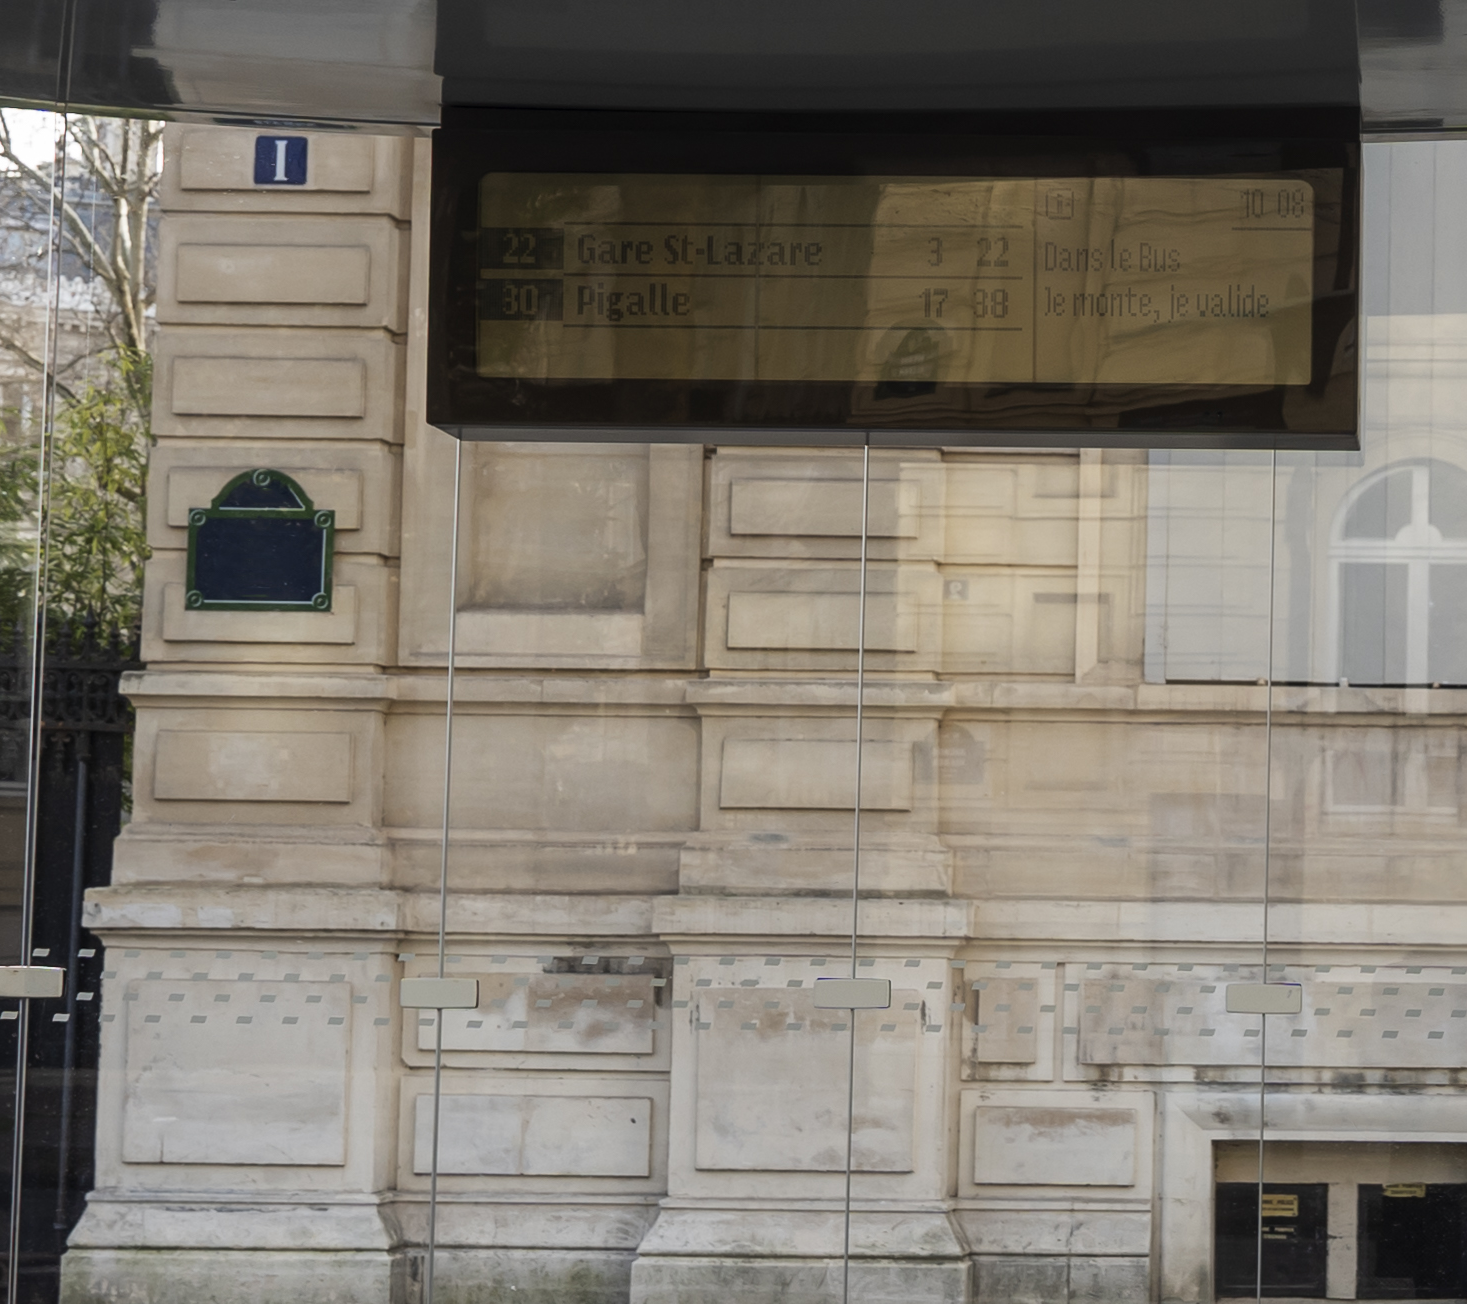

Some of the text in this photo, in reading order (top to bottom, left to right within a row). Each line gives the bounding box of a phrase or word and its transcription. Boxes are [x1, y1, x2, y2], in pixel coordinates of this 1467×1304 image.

[503, 233, 1008, 267] 22 Gare St-Lazare 3 22
[1045, 239, 1181, 271] Dans le Bus
[503, 285, 538, 315] 30
[577, 283, 689, 322] Pigalle
[919, 288, 947, 318] 17
[1073, 286, 1160, 323] monte,
[1168, 285, 1189, 323] je
[1197, 285, 1269, 317] valide
